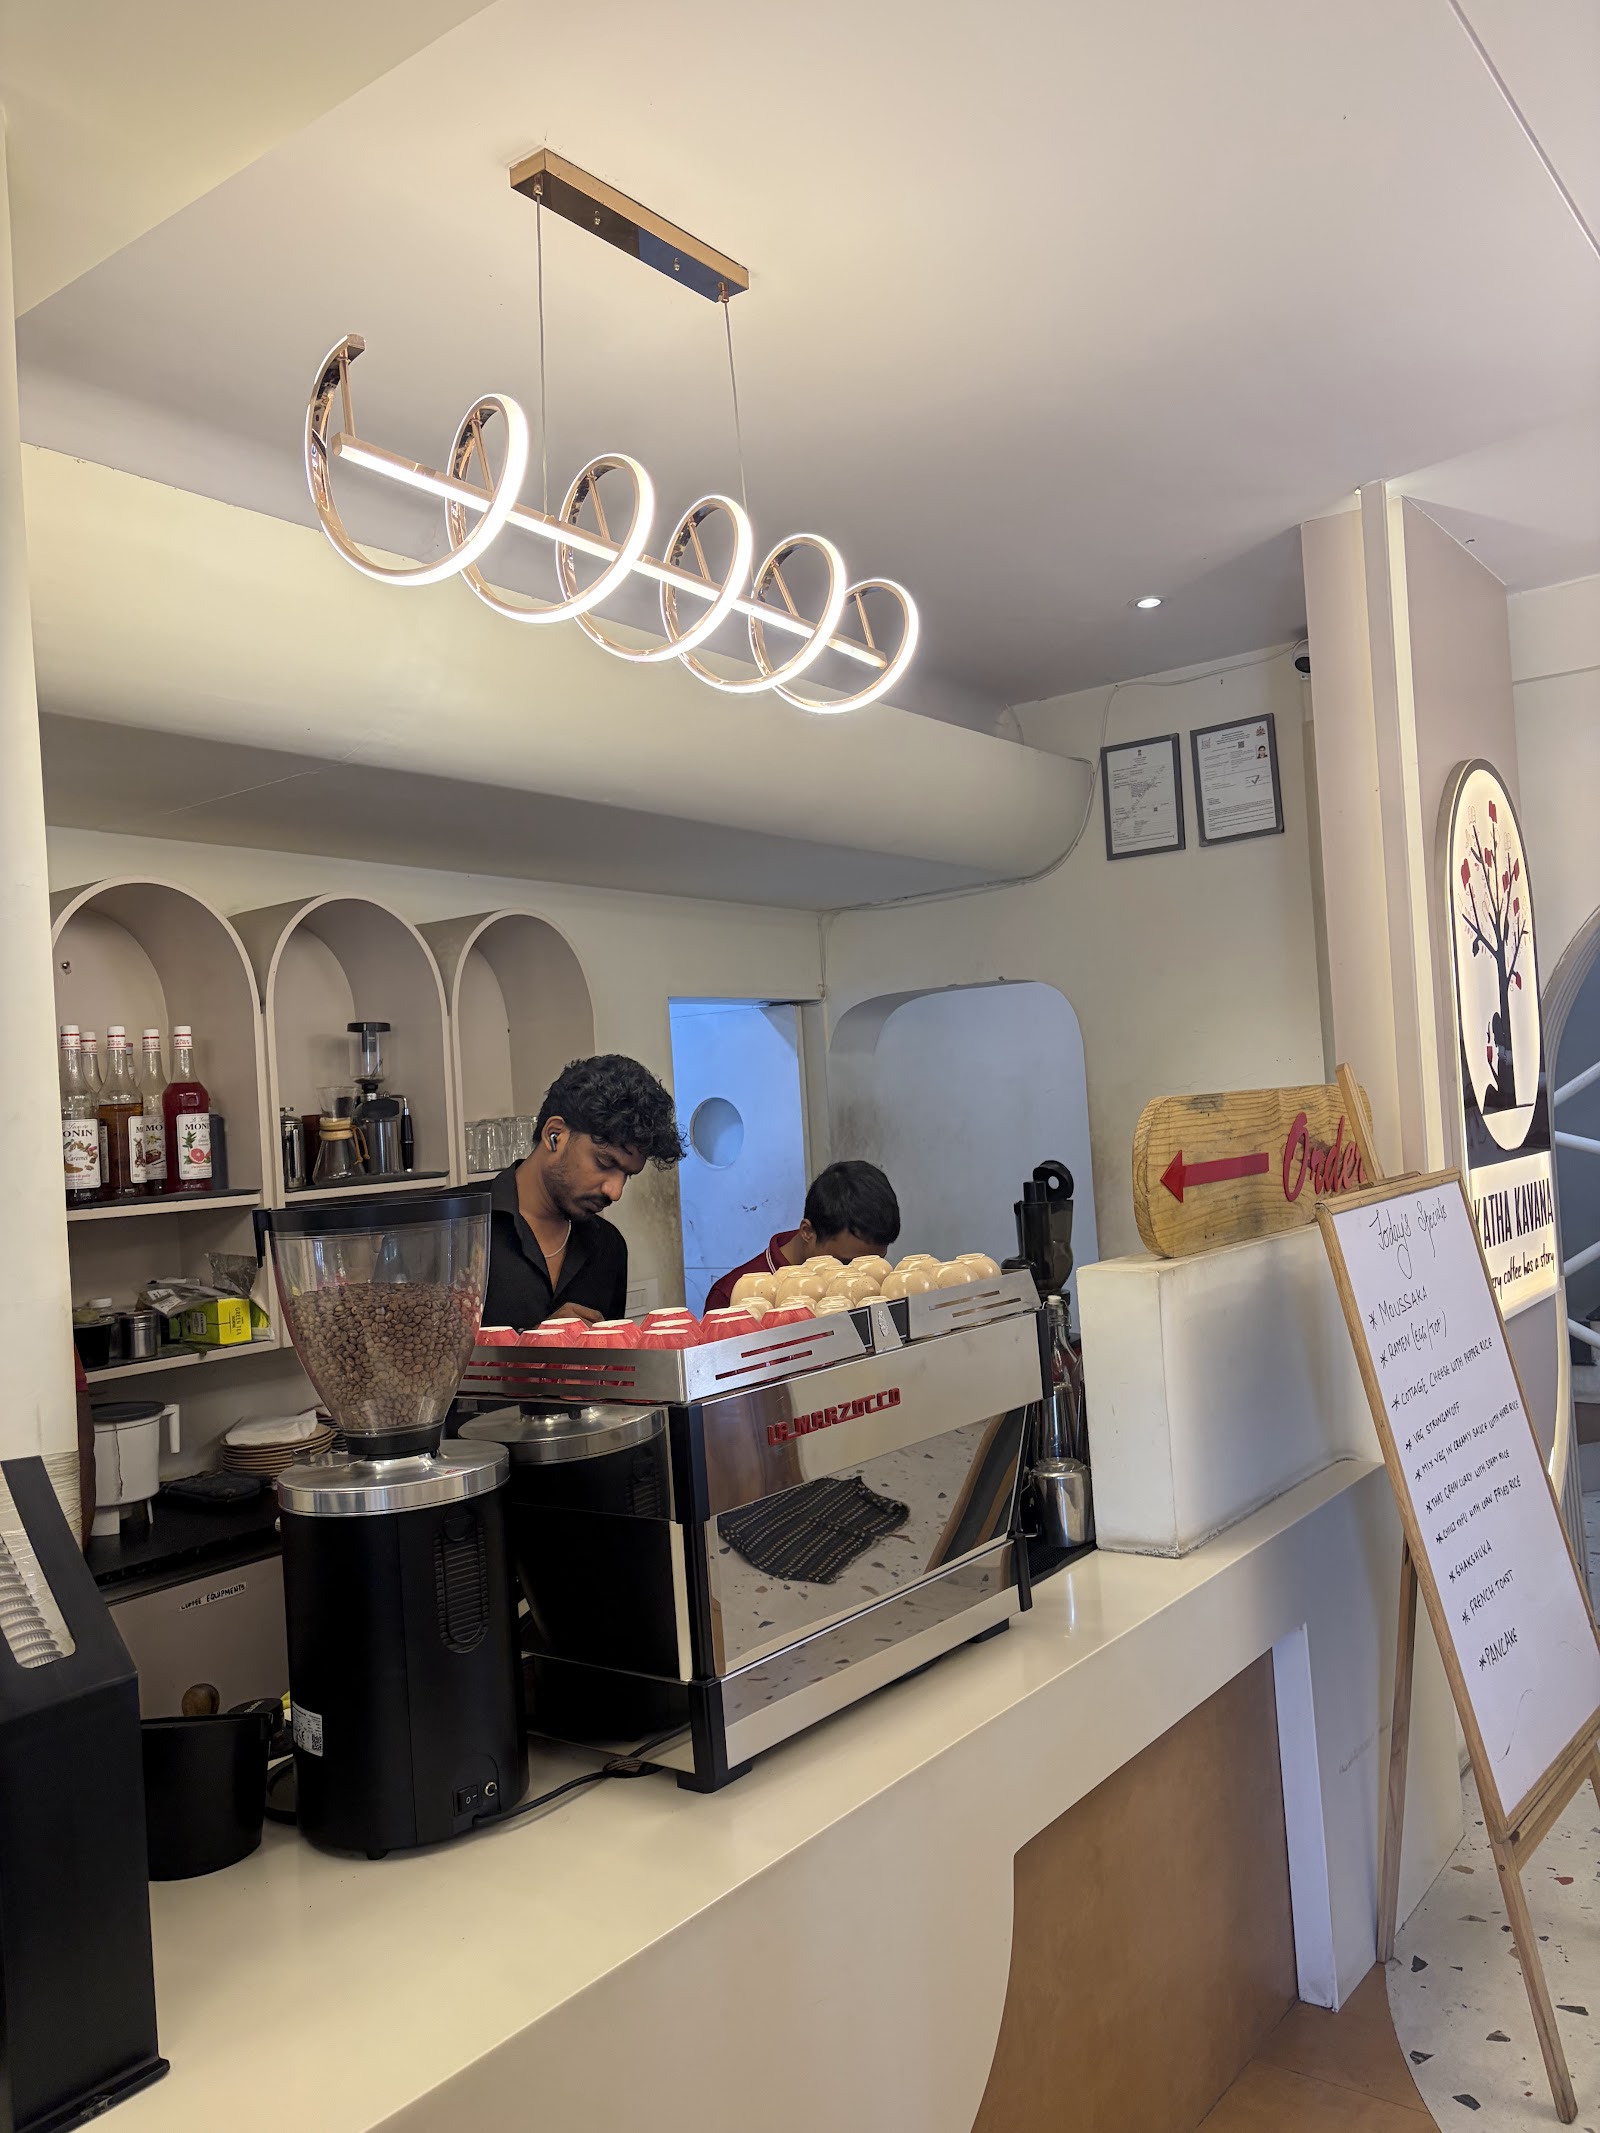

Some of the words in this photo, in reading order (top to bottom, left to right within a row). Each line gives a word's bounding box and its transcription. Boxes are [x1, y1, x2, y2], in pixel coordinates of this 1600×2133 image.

[62, 1129, 93, 1138] ONIN
[1283, 1112, 1367, 1202] Order
[1474, 1190, 1512, 1250] KATHA
[1514, 1178, 1554, 1237] KAVANA
[1369, 1209, 1412, 1279] Today's
[1503, 1255, 1522, 1285] coffee
[1523, 1251, 1534, 1276] has
[1534, 1257, 1540, 1271] a
[1540, 1242, 1555, 1274] story
[1378, 1285, 1429, 1325] MOUSSAKA
[1388, 1333, 1411, 1361] RAMEN
[1400, 1378, 1429, 1405] COTTAGE
[1429, 1364, 1450, 1387] CHEESE
[1450, 1357, 1464, 1373] WITH
[1464, 1345, 1481, 1364] PEPPER
[1479, 1337, 1493, 1351] RICE
[1412, 1428, 1425, 1443] VEG
[1421, 1459, 1434, 1474] MIX
[1434, 1449, 1448, 1464] VEG
[1445, 1444, 1453, 1456] IN
[1453, 1431, 1472, 1451] CREAMY
[1472, 1422, 1488, 1438] SAUCE
[1488, 1413, 1500, 1429] WITH
[1508, 1400, 1519, 1412] RICE
[1459, 1472, 1473, 1488] CURRY
[1474, 1463, 1487, 1479] WITH
[1498, 1448, 1510, 1460] RICE
[1469, 1502, 1481, 1518] WITH
[1493, 1485, 1510, 1503] FRIED
[1508, 1475, 1522, 1491] RICE
[1455, 1539, 1493, 1577] SHAKSHUKA
[206, 1583, 245, 1603] EQUIPMENTS
[1469, 1584, 1496, 1616] FRENCH
[1494, 1569, 1514, 1591] TOAST
[1484, 1627, 1518, 1666] PANCAKE
